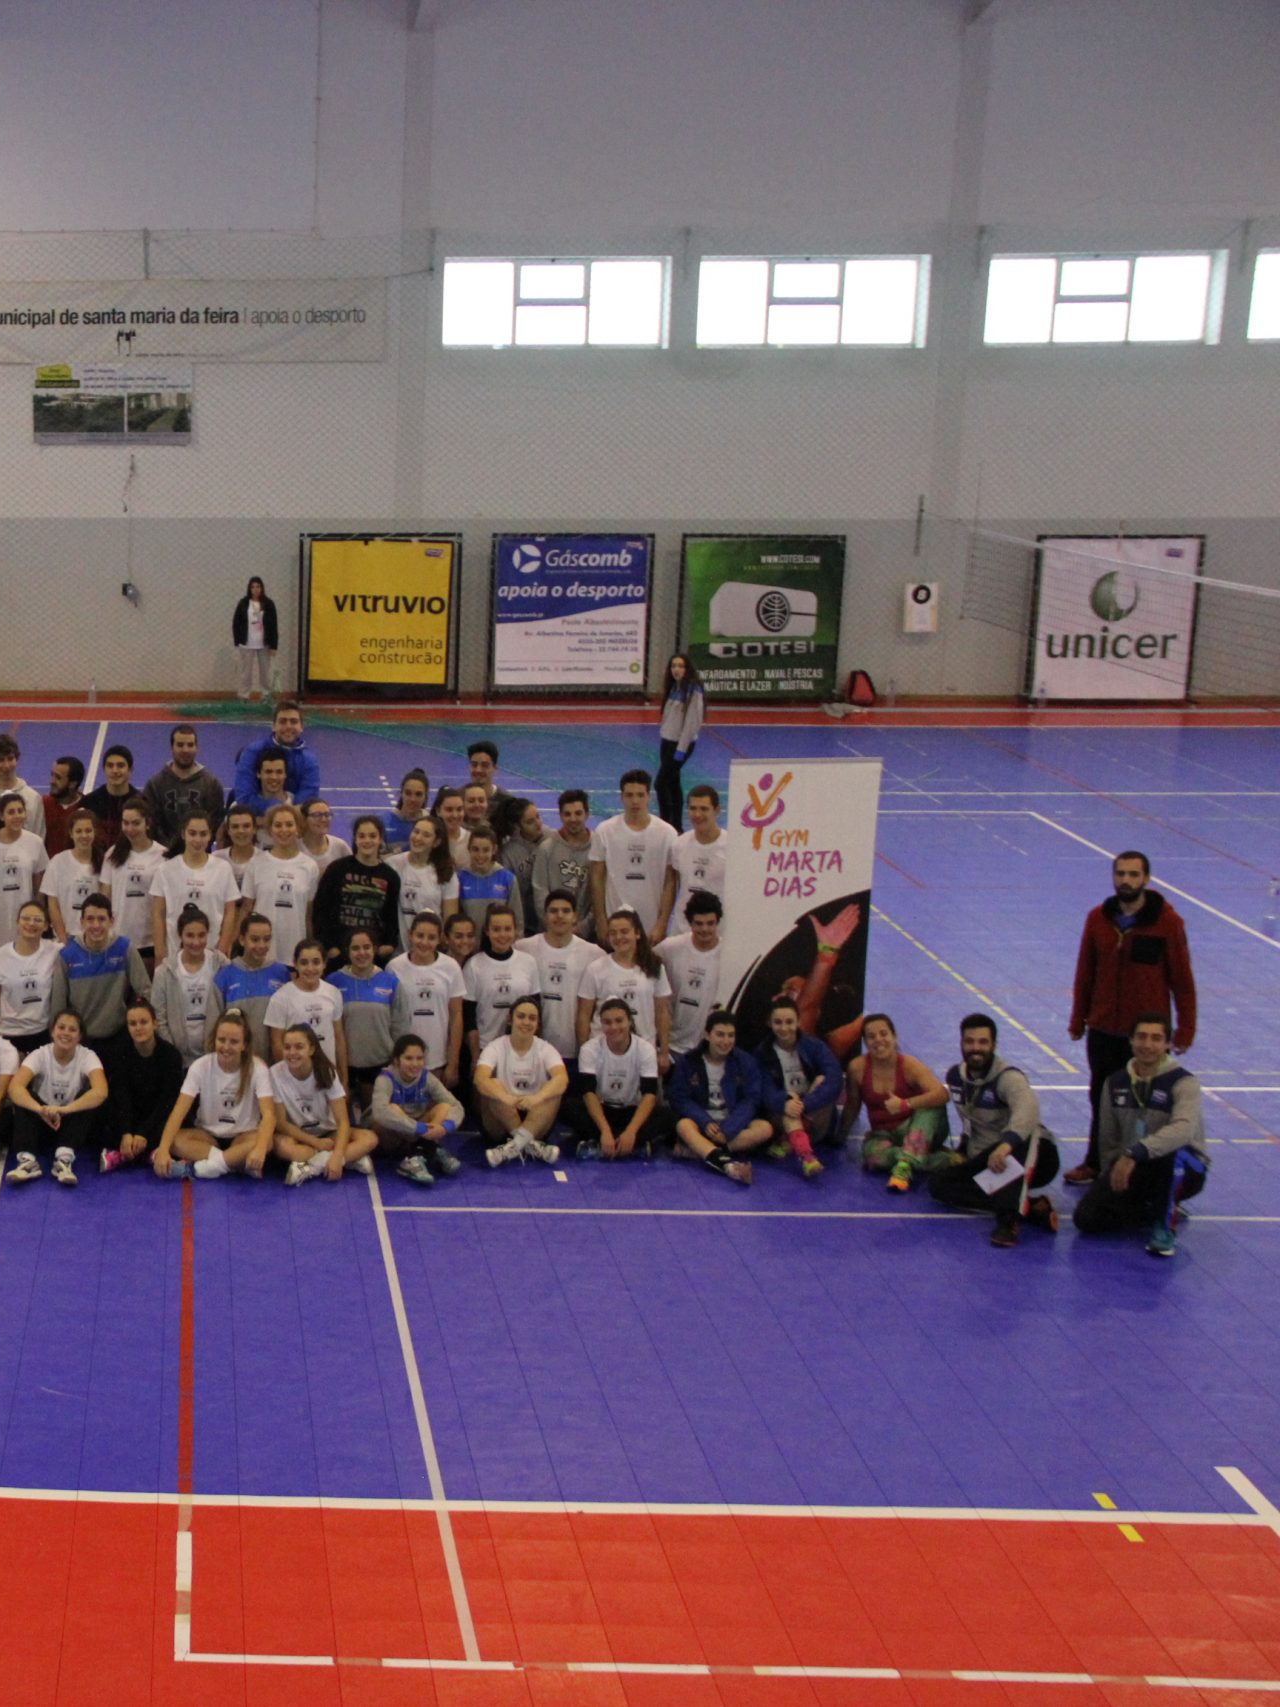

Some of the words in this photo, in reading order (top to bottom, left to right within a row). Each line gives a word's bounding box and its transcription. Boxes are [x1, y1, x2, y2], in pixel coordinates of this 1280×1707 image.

[59, 309, 80, 325] de
[82, 309, 125, 325] santa
[130, 308, 176, 324] maria
[180, 308, 205, 324] da
[205, 307, 240, 324] feira
[251, 308, 290, 327] apoia
[293, 310, 302, 324] o
[305, 307, 367, 326] desporto
[545, 549, 632, 567] Gáscomb
[497, 581, 548, 600] apoia
[551, 585, 562, 597] o
[566, 581, 645, 601] desporto
[360, 635, 443, 652] engenharia
[711, 641, 816, 658] COTESI
[1046, 626, 1178, 659] unicer
[698, 669, 756, 679] NFARDAMENTO
[794, 669, 823, 678] PESCAS
[746, 680, 771, 691] LAZER
[770, 830, 809, 847] GYM
[767, 850, 843, 873] MARTA
[764, 876, 817, 898] DIAS
